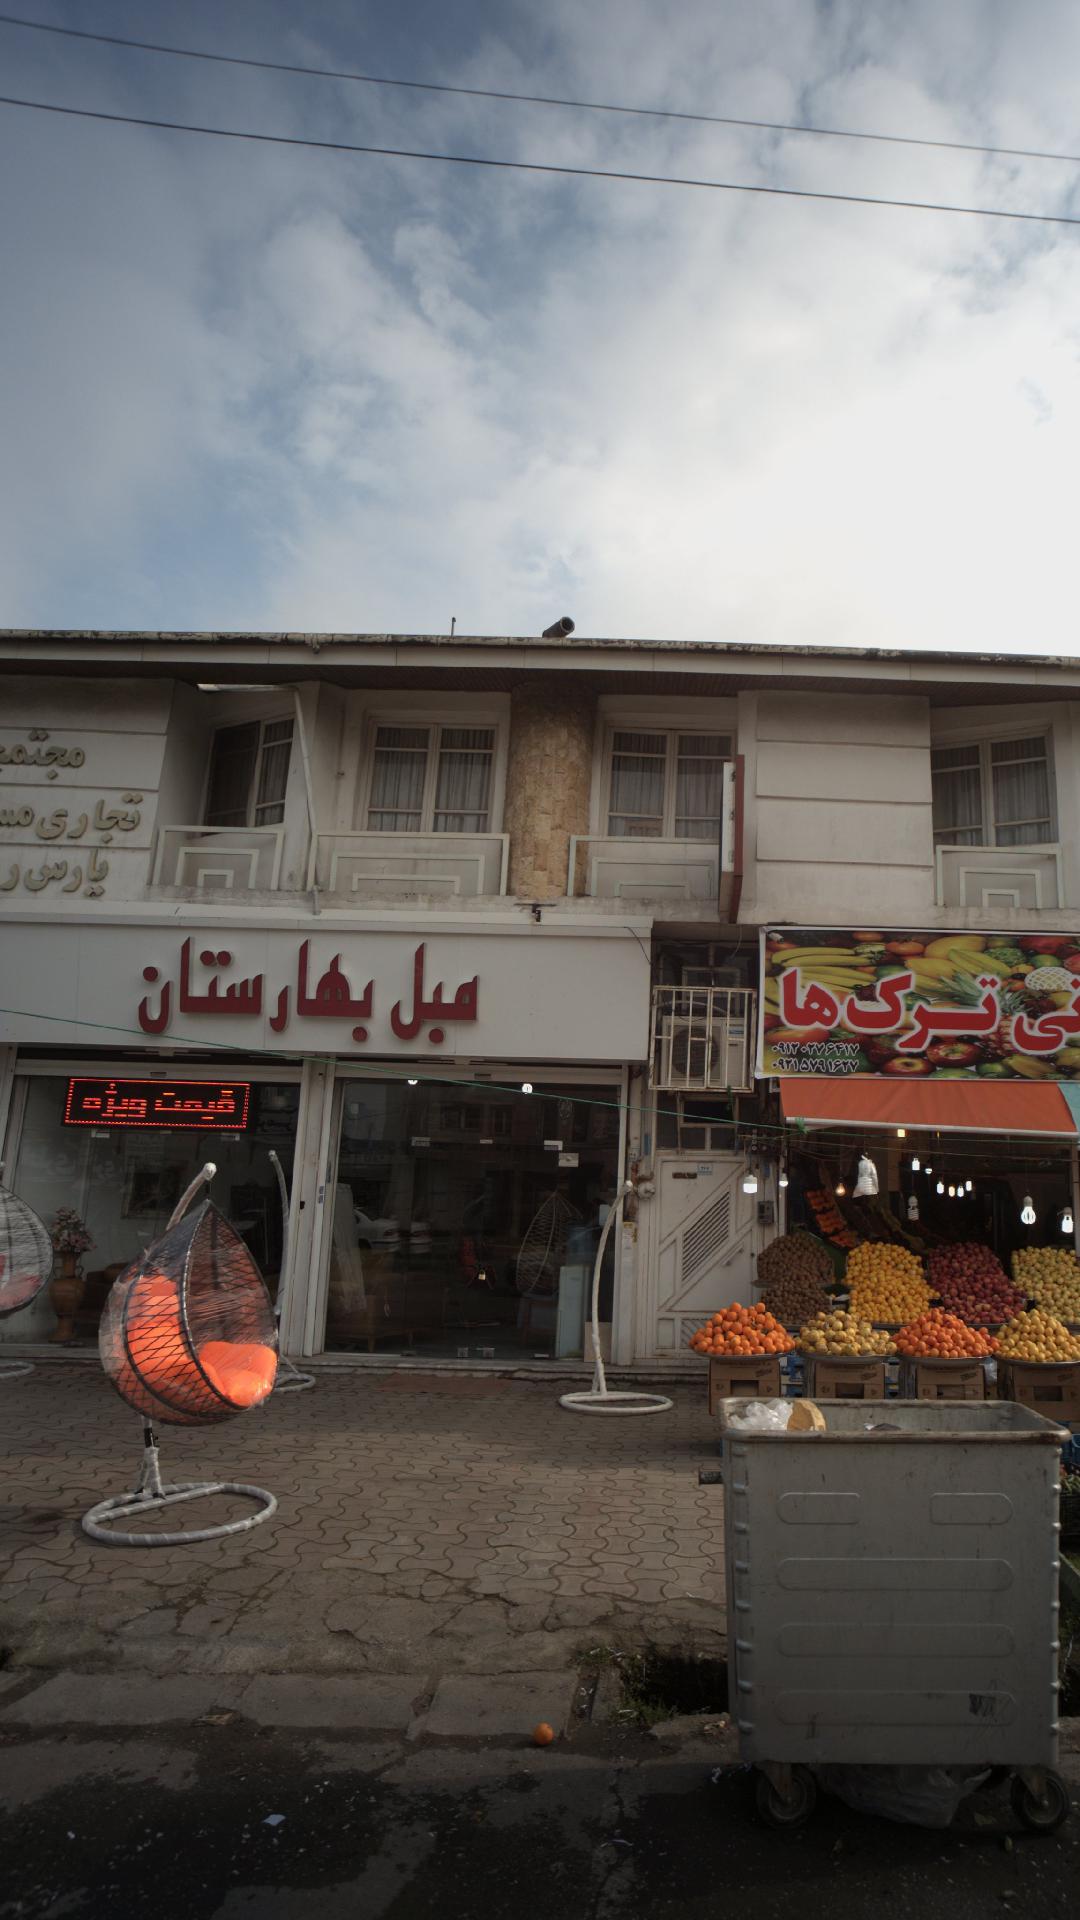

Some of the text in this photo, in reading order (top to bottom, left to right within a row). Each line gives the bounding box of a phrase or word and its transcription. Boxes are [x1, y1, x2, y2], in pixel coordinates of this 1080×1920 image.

[35, 792, 144, 844] تجاری
[138, 936, 480, 1044] مبل بهارستان
[154, 1089, 236, 1120] قیمت
